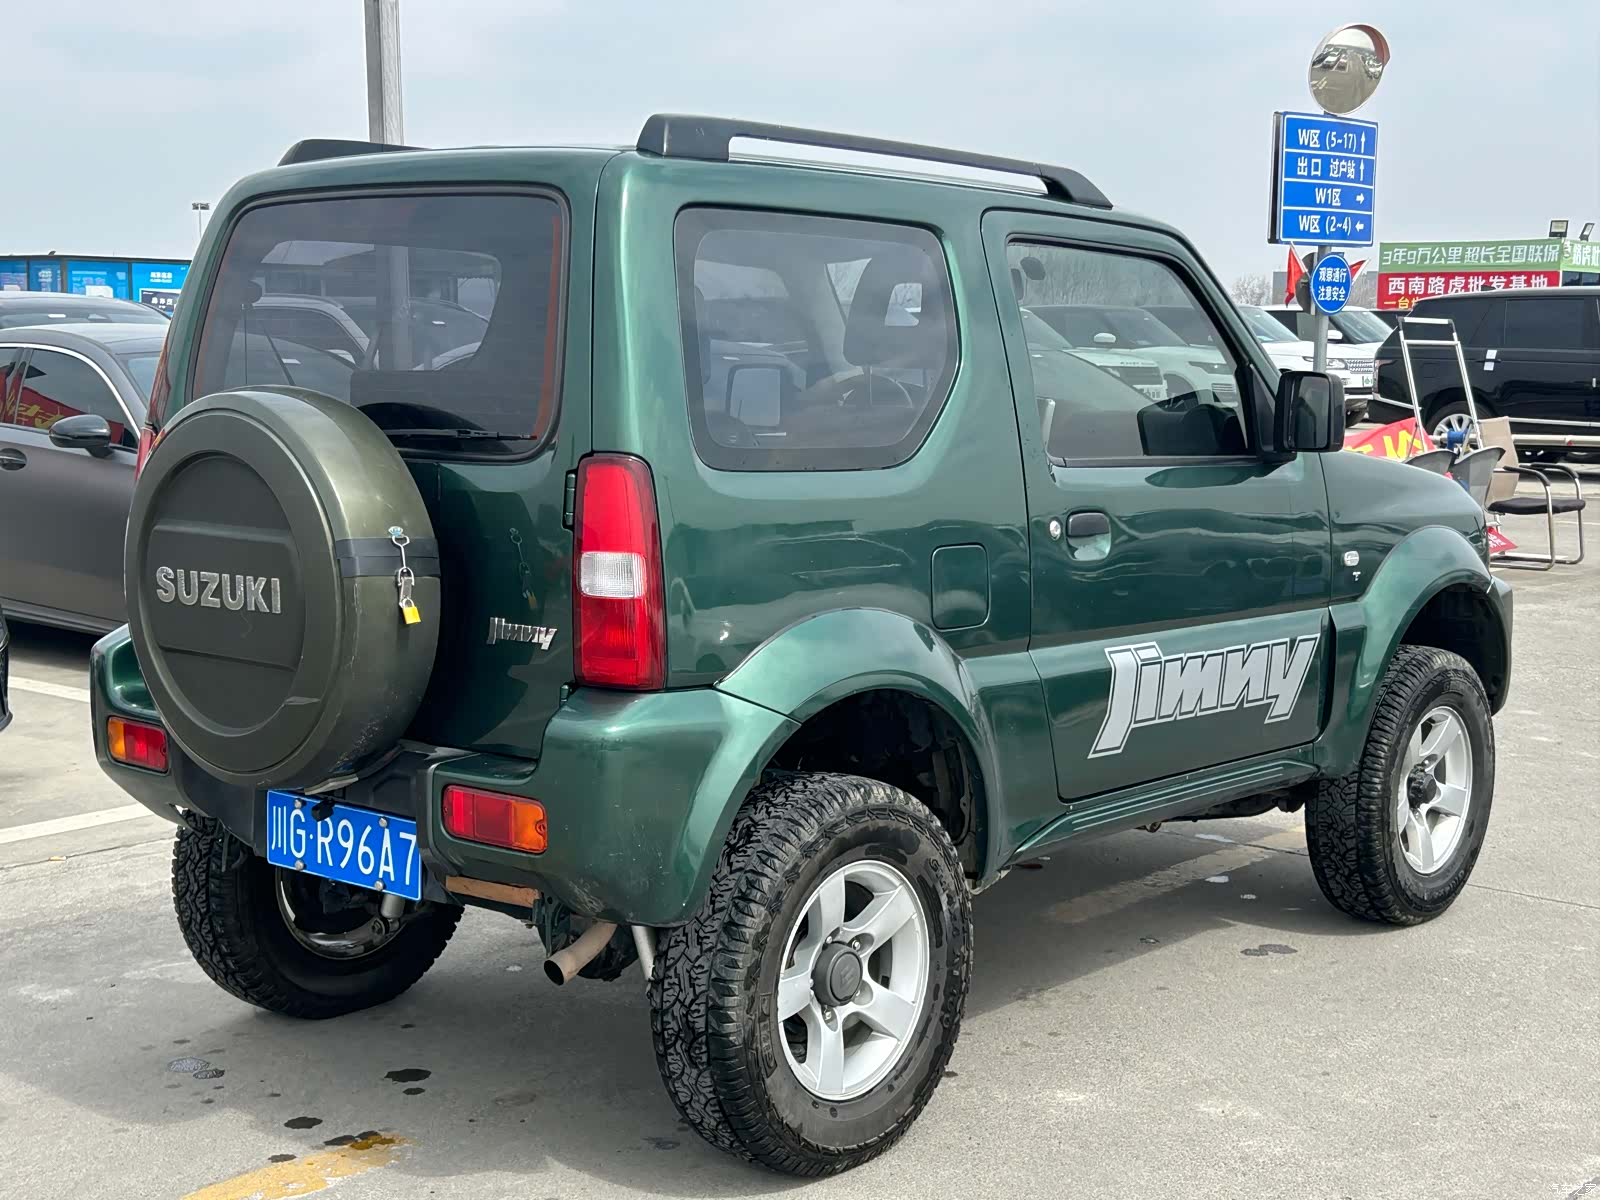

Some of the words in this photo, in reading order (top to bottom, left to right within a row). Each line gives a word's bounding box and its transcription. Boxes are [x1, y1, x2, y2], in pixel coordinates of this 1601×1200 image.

[1298, 128, 1320, 147] W区
[1297, 156, 1322, 177] 出口
[1329, 158, 1356, 179] 过户站
[1315, 187, 1342, 206] W1区
[1299, 214, 1321, 233] W区
[1318, 267, 1347, 282] 观察通行
[1317, 285, 1347, 302] 注意安全
[155, 566, 282, 615] SUZUKI
[488, 616, 557, 650] Jimny
[1088, 633, 1321, 759] Jimny
